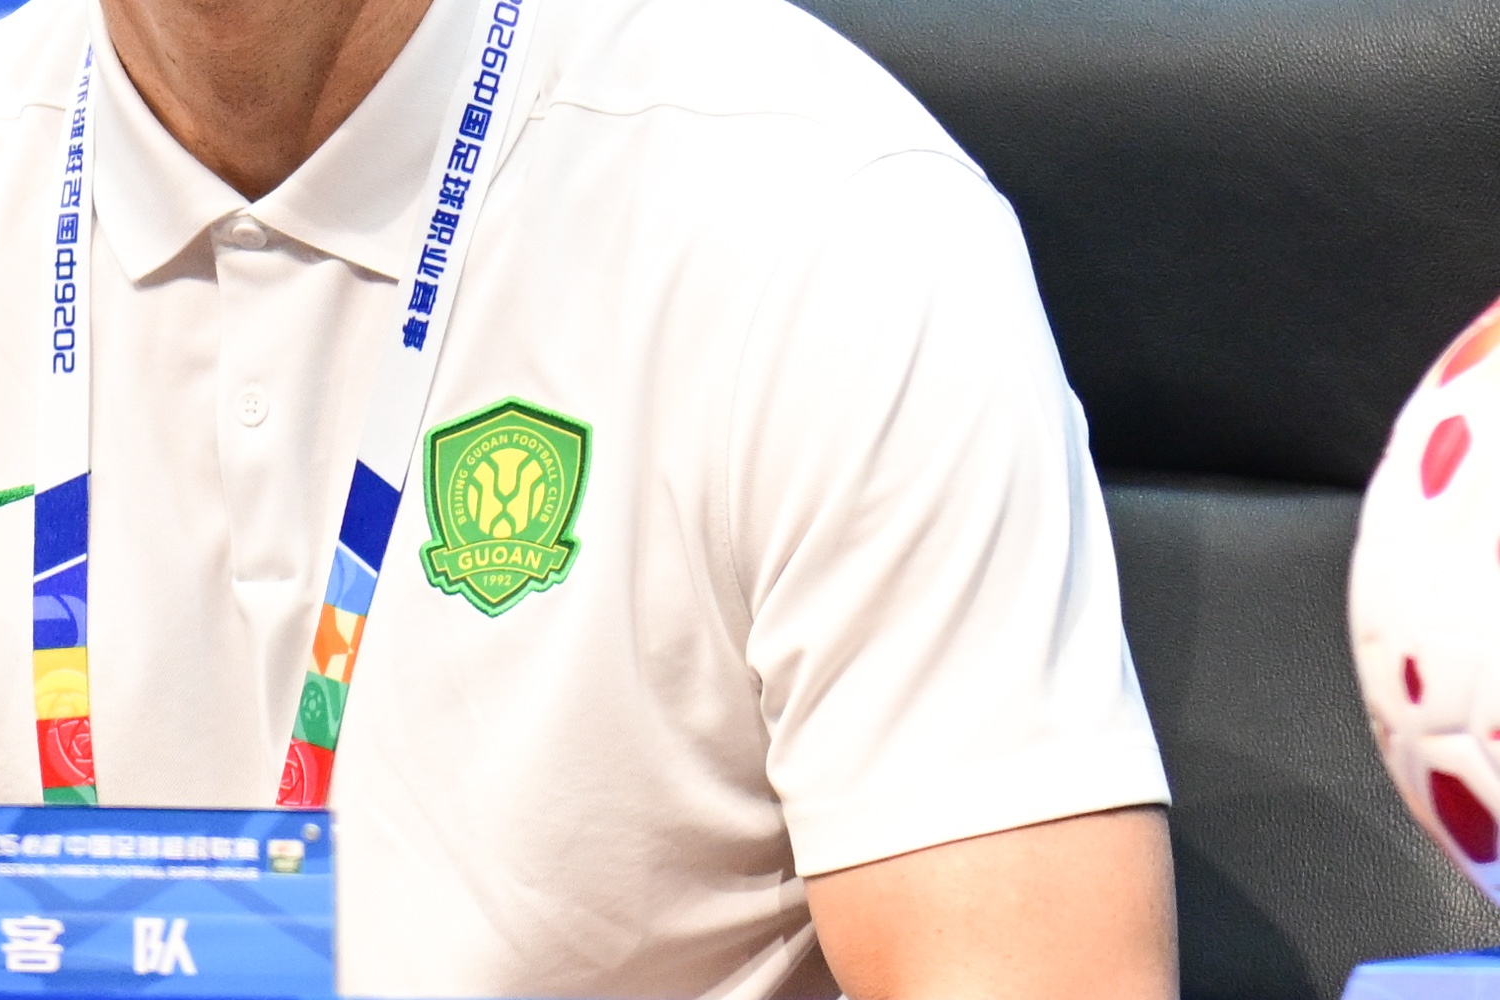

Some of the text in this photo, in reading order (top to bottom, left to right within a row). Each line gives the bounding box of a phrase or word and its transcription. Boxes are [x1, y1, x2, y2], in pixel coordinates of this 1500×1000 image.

[454, 433, 558, 525] BEIJING GUOAN FOOTBALL CLUB
[458, 546, 542, 571] GUOAN
[482, 575, 512, 587] 1992
